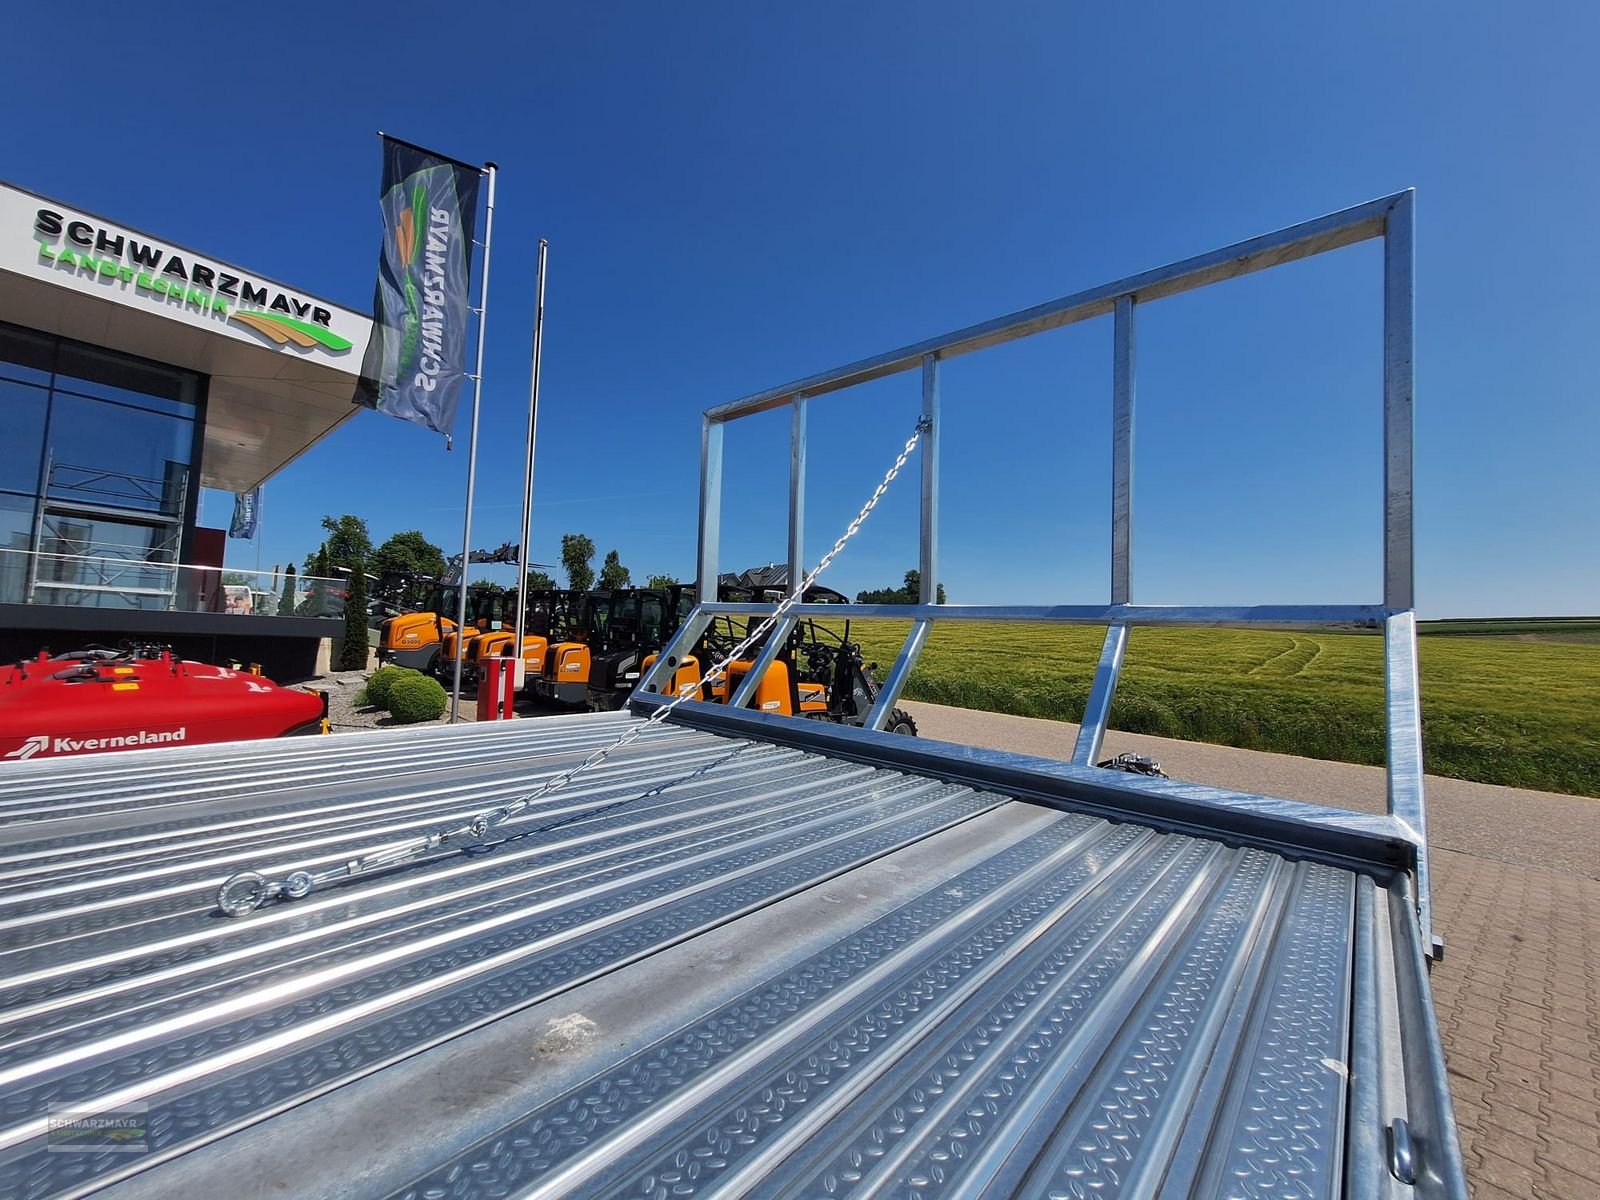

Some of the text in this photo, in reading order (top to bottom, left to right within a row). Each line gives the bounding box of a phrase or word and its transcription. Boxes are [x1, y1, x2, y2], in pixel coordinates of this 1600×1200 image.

[36, 209, 332, 327] SCHWARZMAYR
[40, 241, 228, 315] LANDTECHNIK
[54, 727, 186, 753] Kverneland
